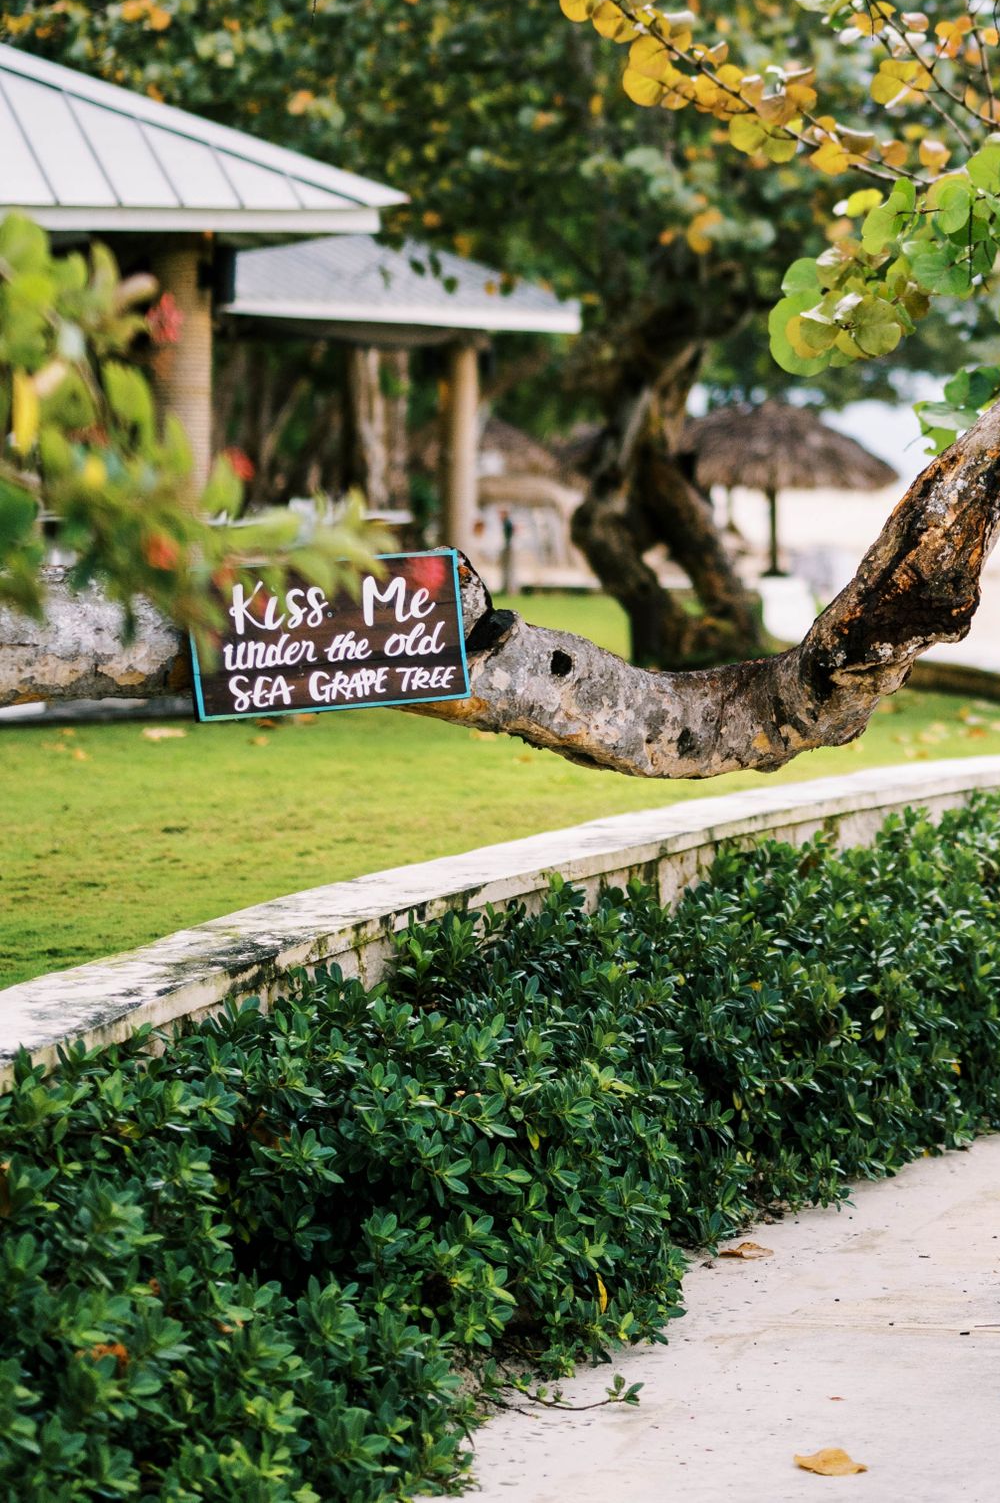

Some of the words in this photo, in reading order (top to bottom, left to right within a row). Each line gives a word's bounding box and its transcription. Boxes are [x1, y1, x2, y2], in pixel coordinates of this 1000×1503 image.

[229, 581, 329, 635] Kiss
[363, 575, 436, 627] Me
[223, 633, 317, 671] under
[324, 631, 373, 663] the
[383, 621, 446, 657] old
[228, 674, 296, 712] SEA
[308, 666, 390, 703] GRAPE
[395, 666, 457, 692] TREE
